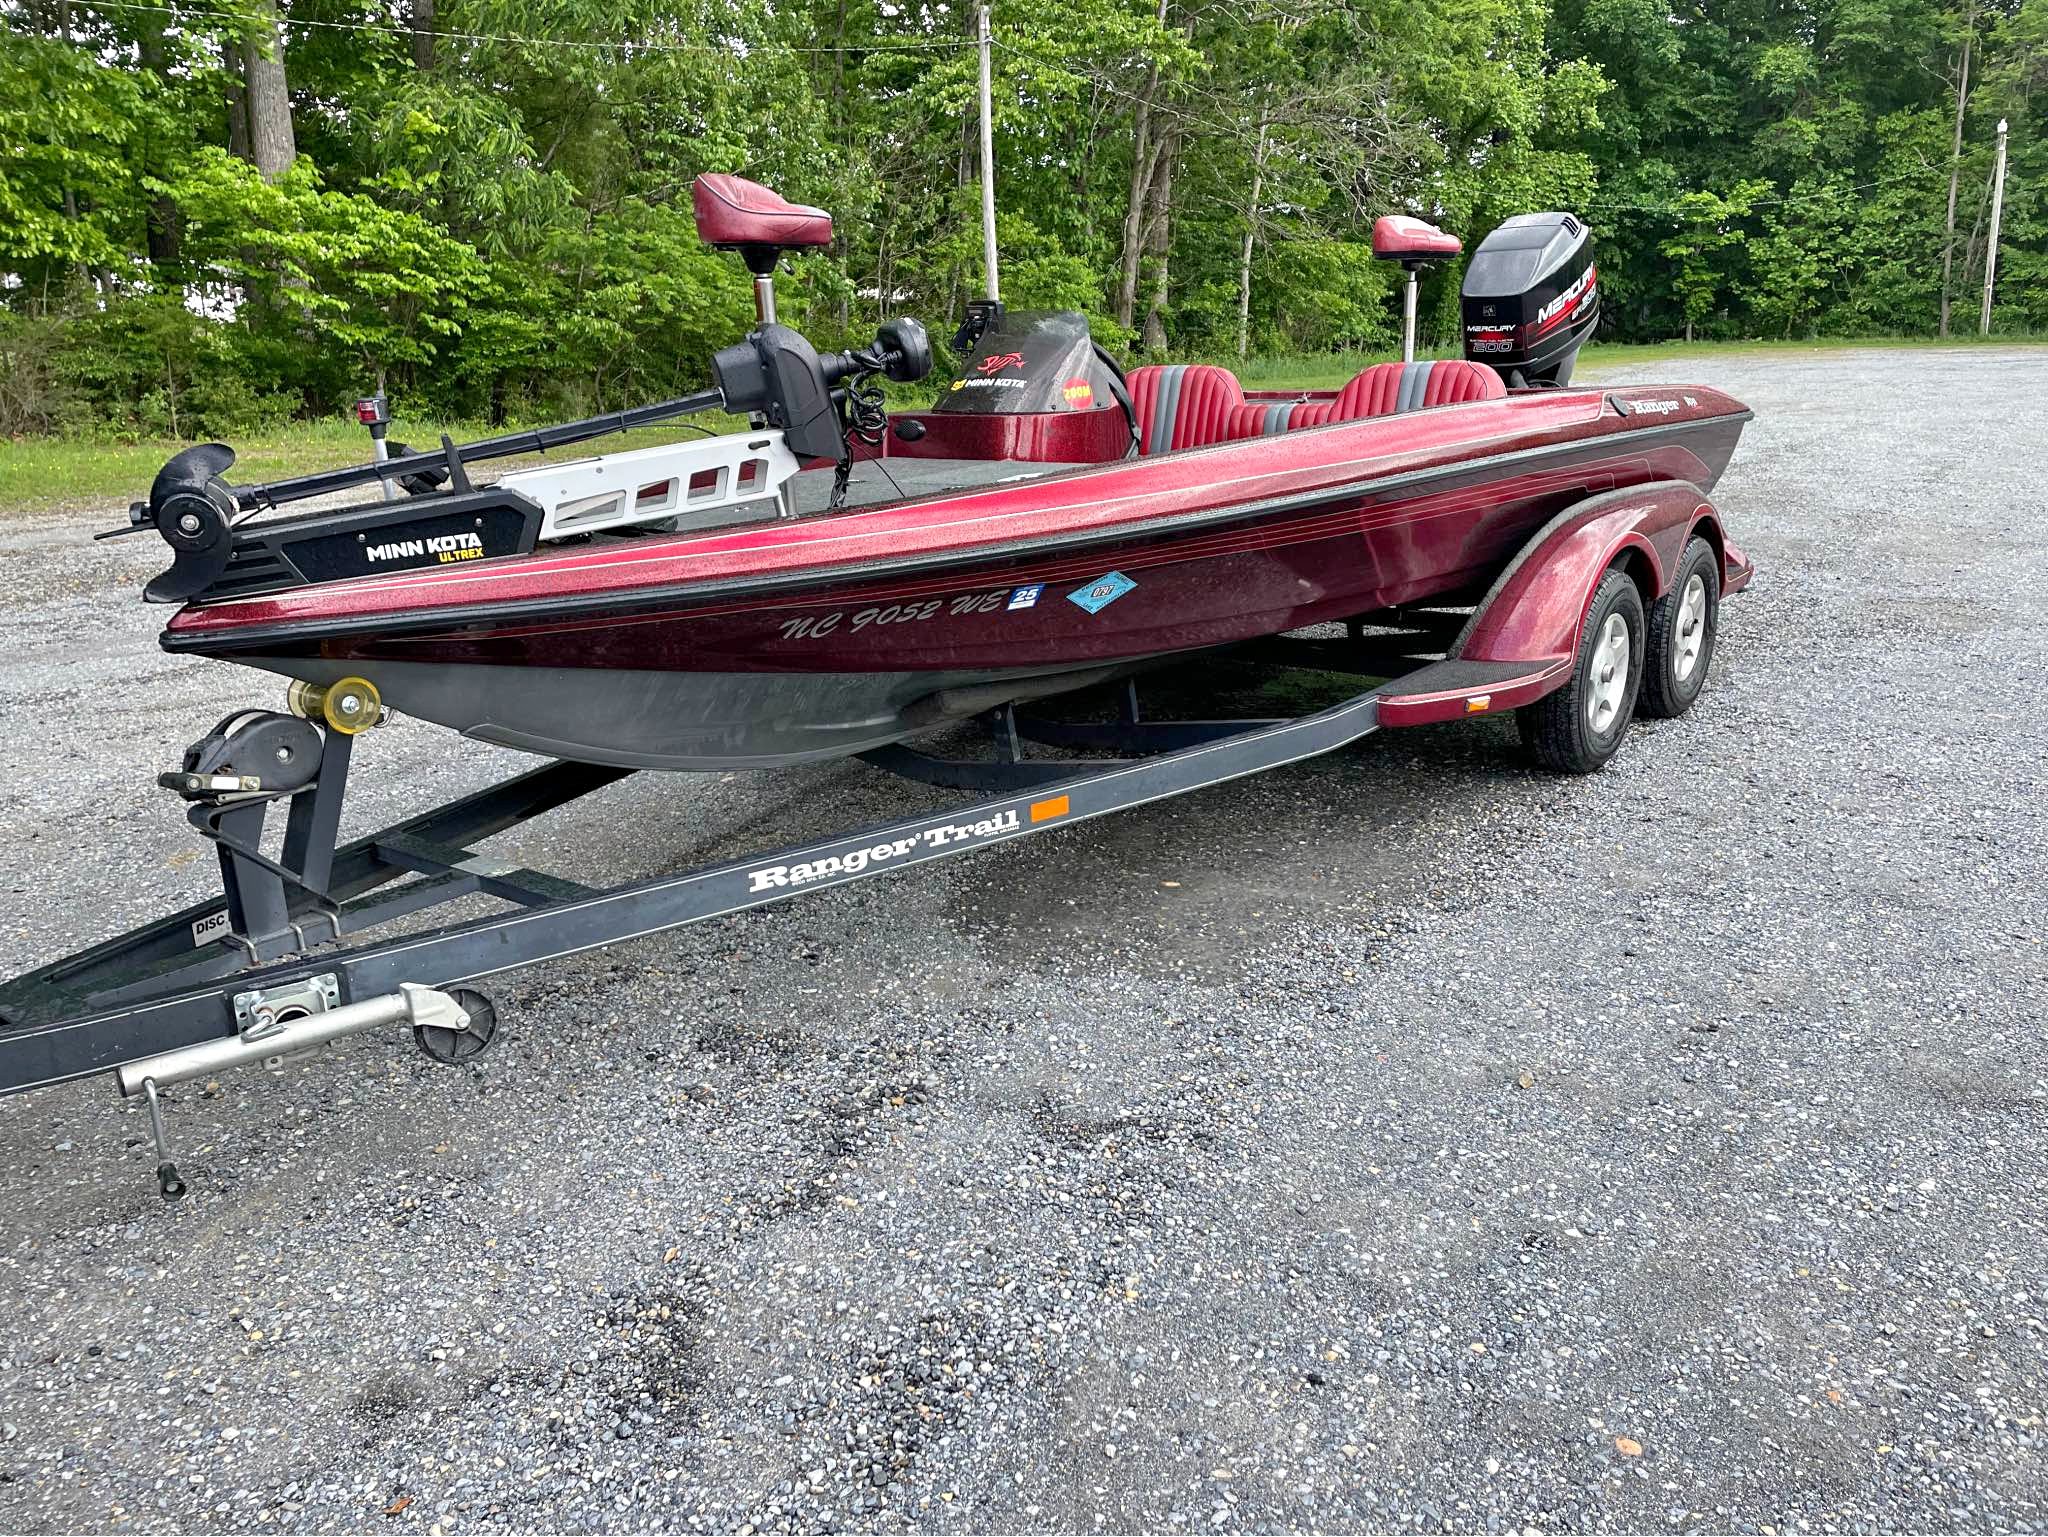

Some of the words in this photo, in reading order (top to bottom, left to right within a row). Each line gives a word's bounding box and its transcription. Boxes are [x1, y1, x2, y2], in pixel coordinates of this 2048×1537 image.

[1537, 261, 1594, 324] MERCURY
[1466, 324, 1517, 332] MERCURY
[1473, 342, 1512, 352] 200
[965, 378, 995, 387] MINN
[995, 378, 1026, 388] KOTA
[1630, 400, 1680, 415] Ranger
[366, 540, 424, 562] MINN
[426, 532, 482, 553] KOTA
[439, 547, 484, 562] ULTREX
[1013, 588, 1040, 602] 25
[1092, 585, 1115, 597] 0797
[779, 612, 843, 640] NC
[850, 600, 943, 634] 9052
[951, 589, 1010, 616] WE
[923, 809, 1020, 848] Trail
[196, 914, 226, 935] DISC
